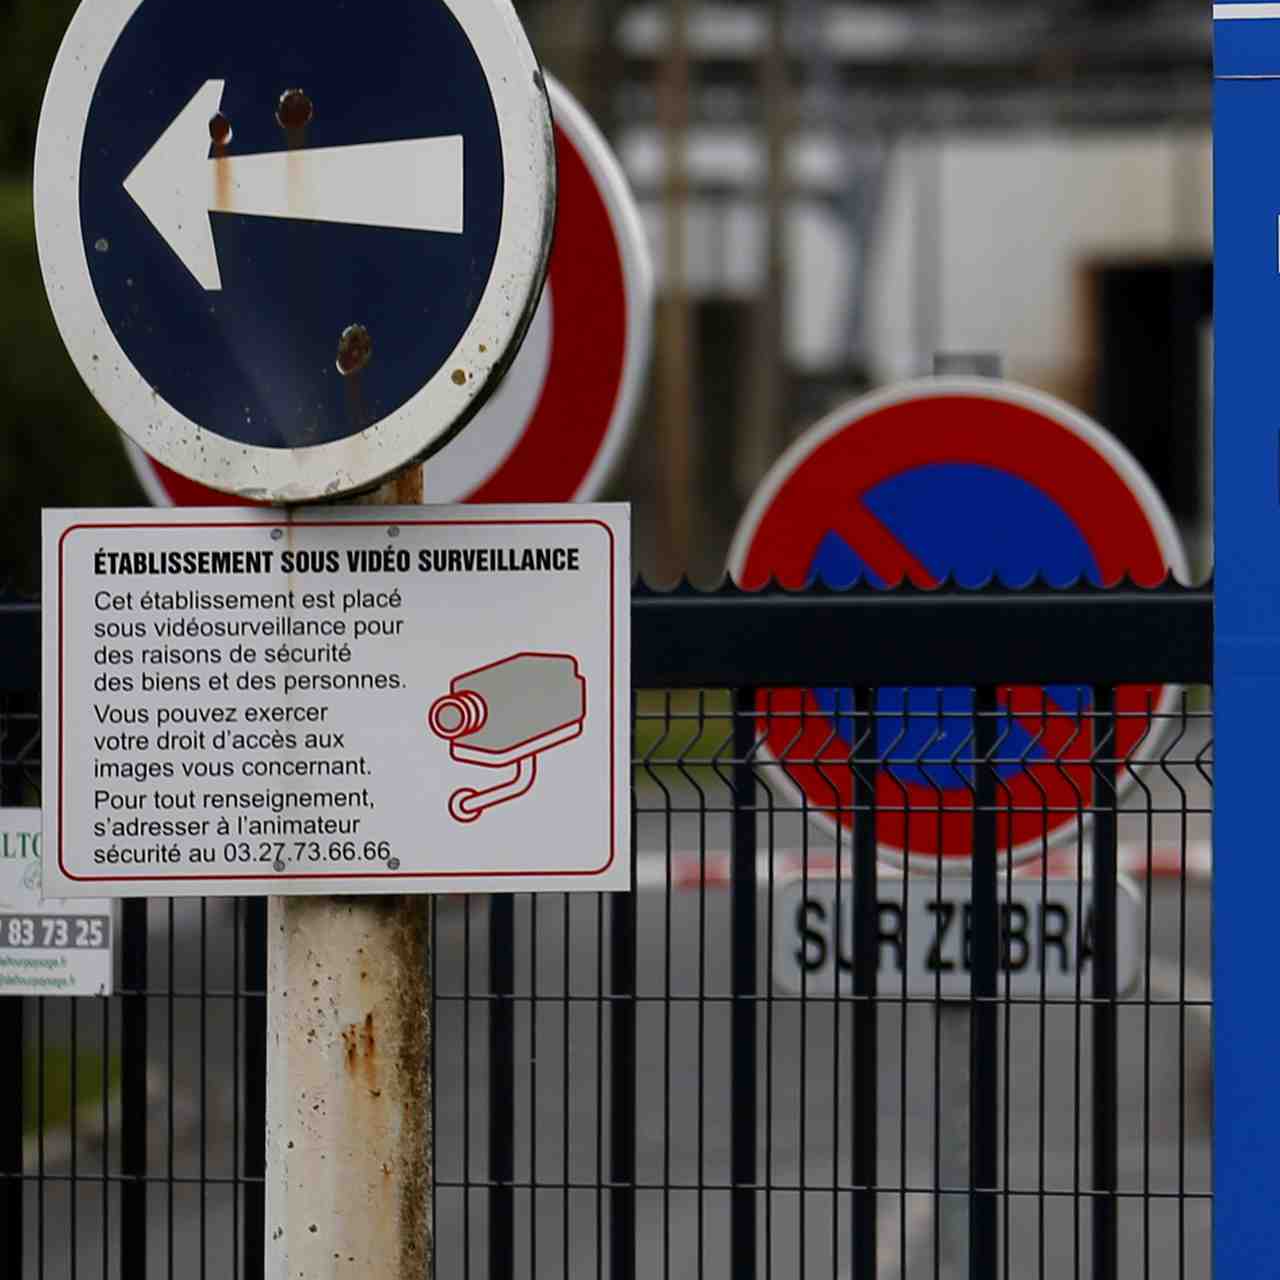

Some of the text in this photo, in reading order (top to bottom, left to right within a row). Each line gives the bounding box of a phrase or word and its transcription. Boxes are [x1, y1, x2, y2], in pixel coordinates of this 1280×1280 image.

[94, 544, 580, 576] ÉTABLISSEMENT SOUS VIDÉO SURVEILLANCE
[94, 588, 402, 613] Cet établissement est placé
[94, 616, 404, 640] sous vidéosurveillance pour
[94, 642, 352, 665] des raisons de sécurité
[94, 671, 407, 695] des biens et des personnes.
[94, 705, 328, 727] Vous pouvez exercer
[94, 729, 345, 751] votre droit d'accès aux
[94, 756, 371, 782] images vous concernant.
[94, 789, 374, 812] Pour tout renseignement,
[94, 815, 361, 837] s'adresser à l'animateur
[94, 840, 391, 865] sécurité au 03.27.73.66.66
[7, 918, 103, 947] 83 73 25
